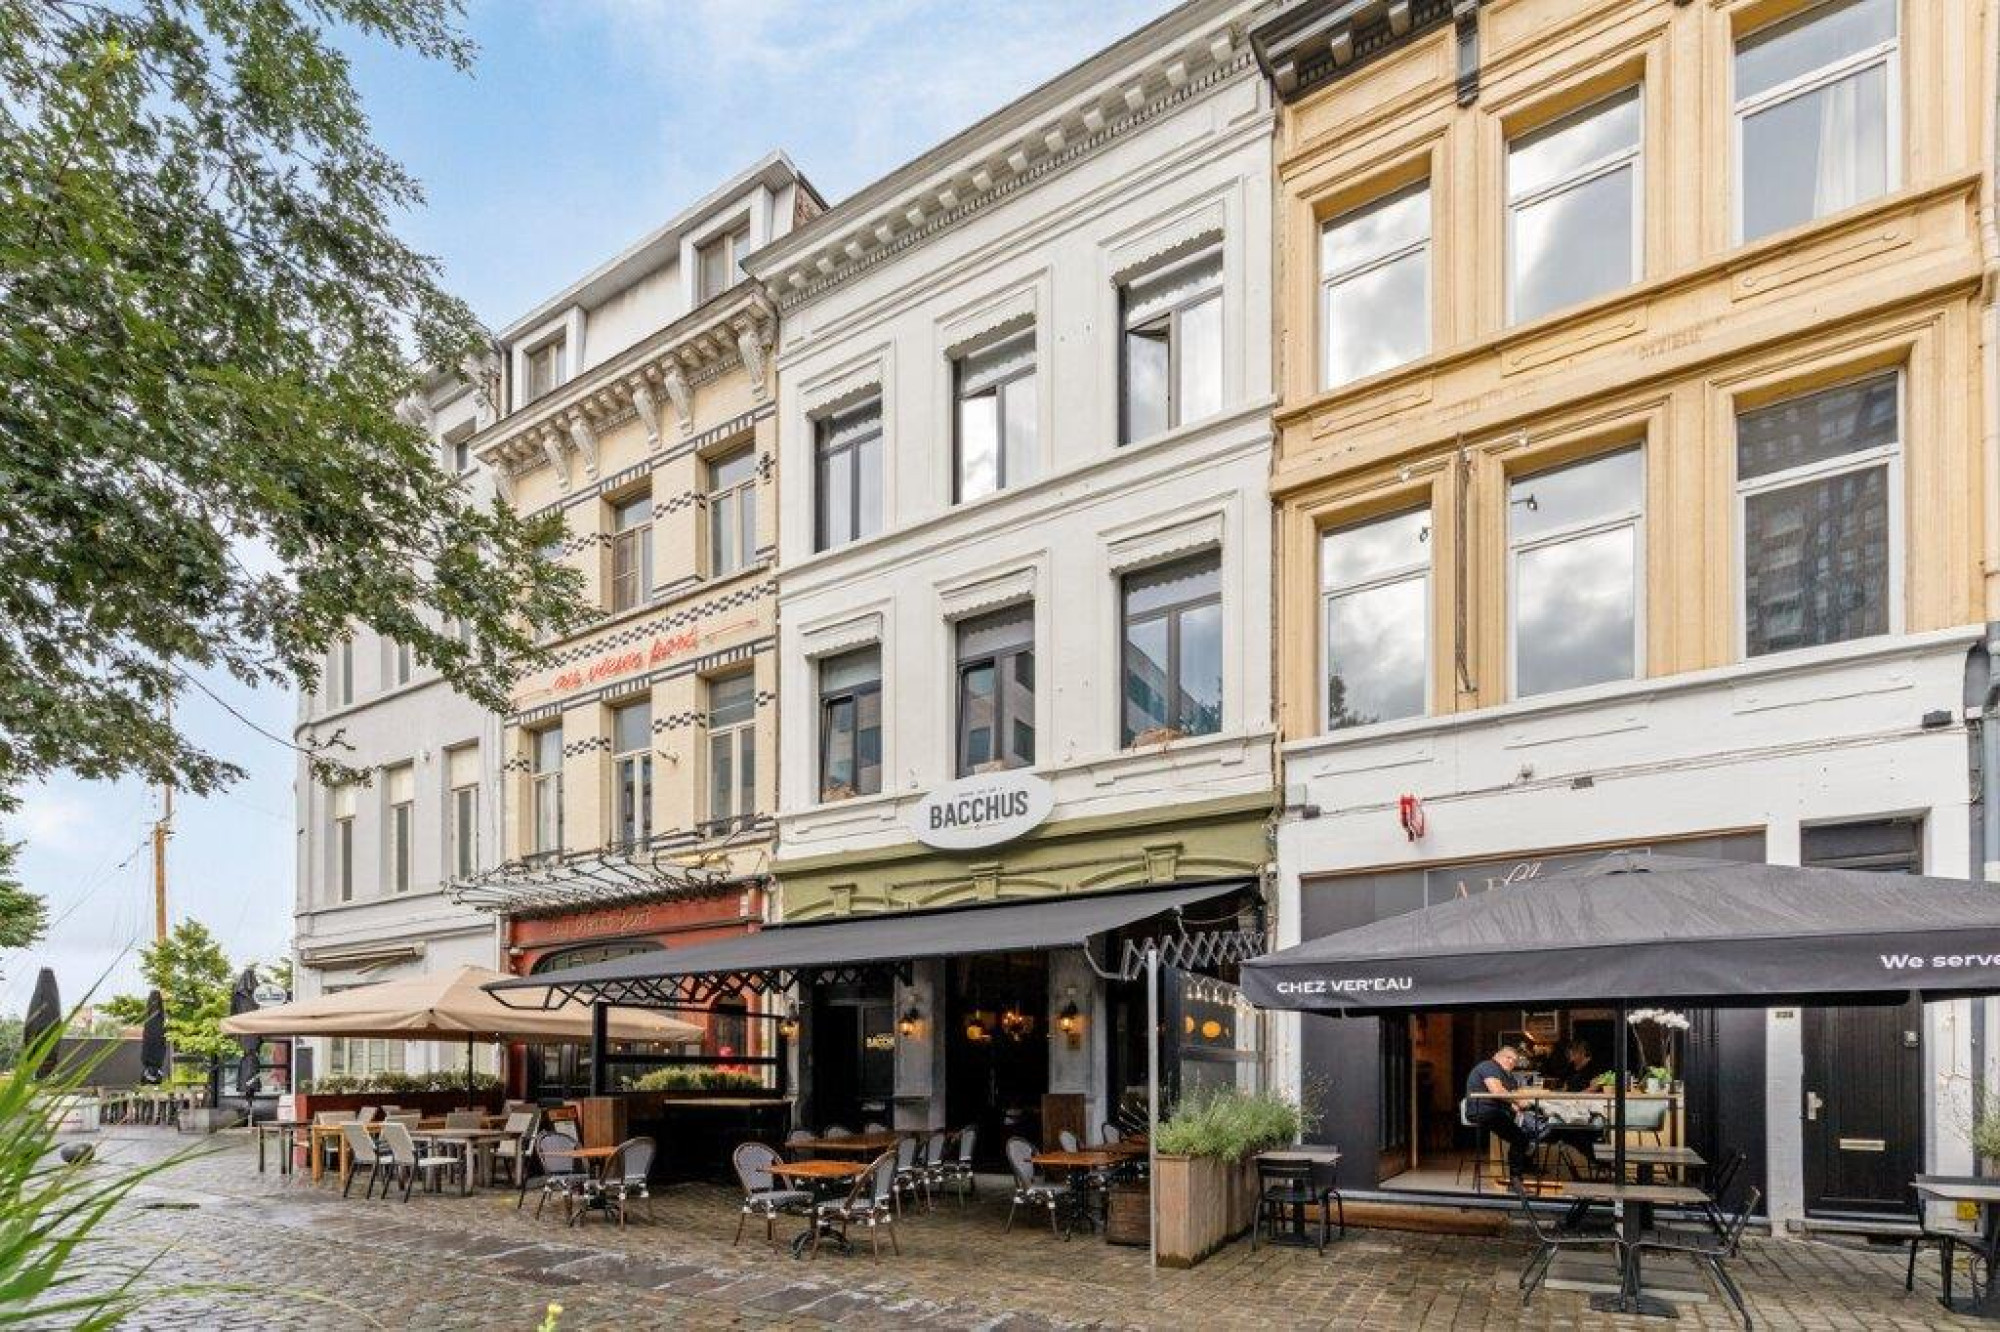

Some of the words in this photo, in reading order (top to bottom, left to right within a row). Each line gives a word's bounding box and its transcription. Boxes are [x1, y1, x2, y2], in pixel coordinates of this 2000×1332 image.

[929, 791, 1028, 830] BACCHUS
[1880, 954, 1925, 970] We
[1932, 954, 2000, 968] serve
[1276, 980, 1327, 993] CHEZ
[1331, 976, 1413, 991] VER'EAU
